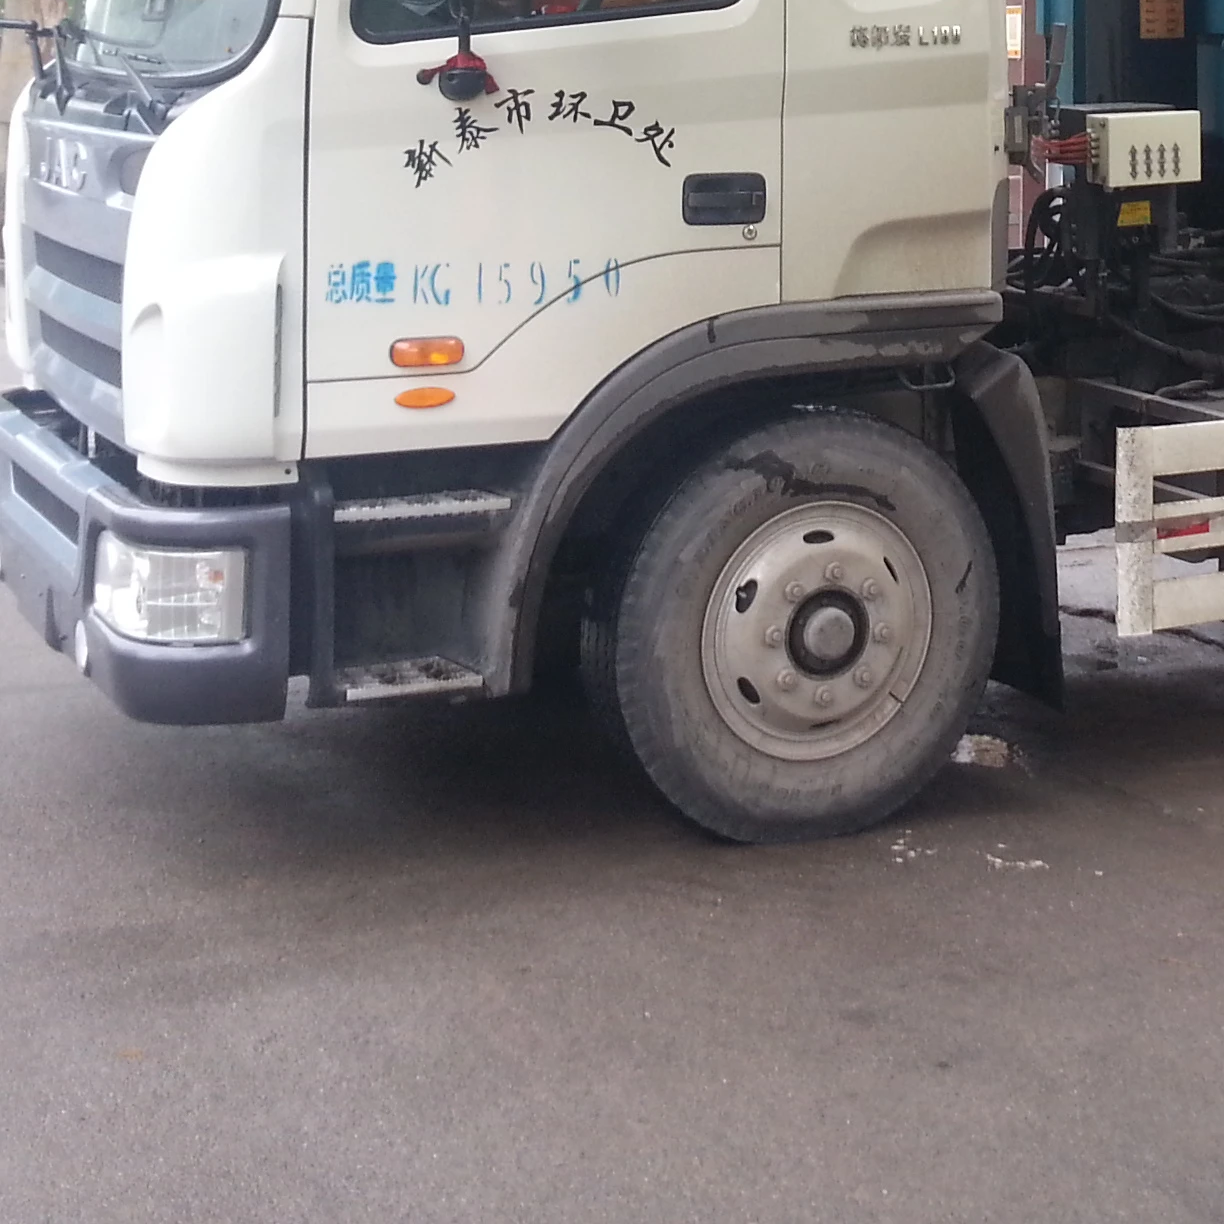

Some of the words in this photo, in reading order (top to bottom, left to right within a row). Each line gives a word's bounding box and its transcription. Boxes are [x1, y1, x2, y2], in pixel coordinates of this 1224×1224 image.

[404, 88, 676, 188] 新泰市环卫处
[325, 259, 397, 305] 总质量
[413, 261, 451, 306] KG
[476, 257, 621, 306] 15950
